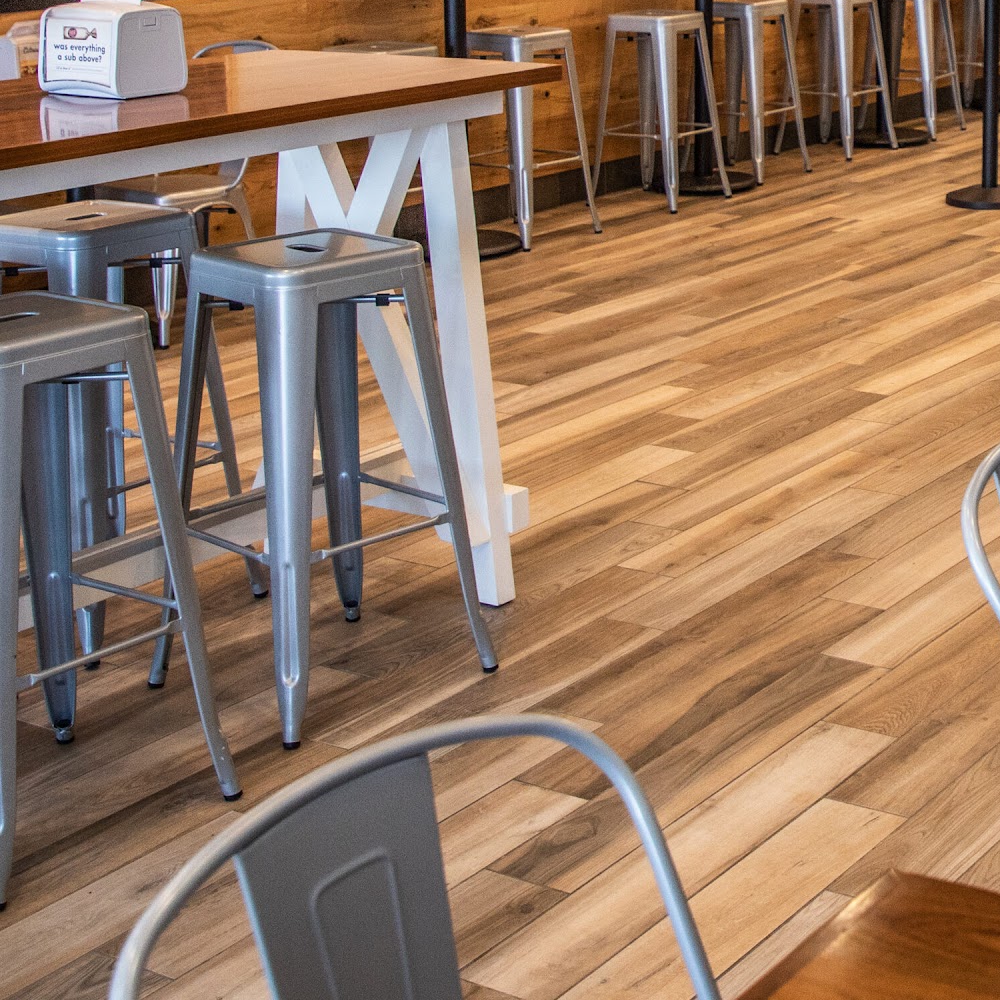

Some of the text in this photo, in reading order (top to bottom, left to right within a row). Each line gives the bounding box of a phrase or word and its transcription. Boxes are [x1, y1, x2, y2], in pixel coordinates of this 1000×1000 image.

[70, 43, 106, 55] everything
[64, 53, 77, 61] sub
[79, 54, 102, 63] above?
